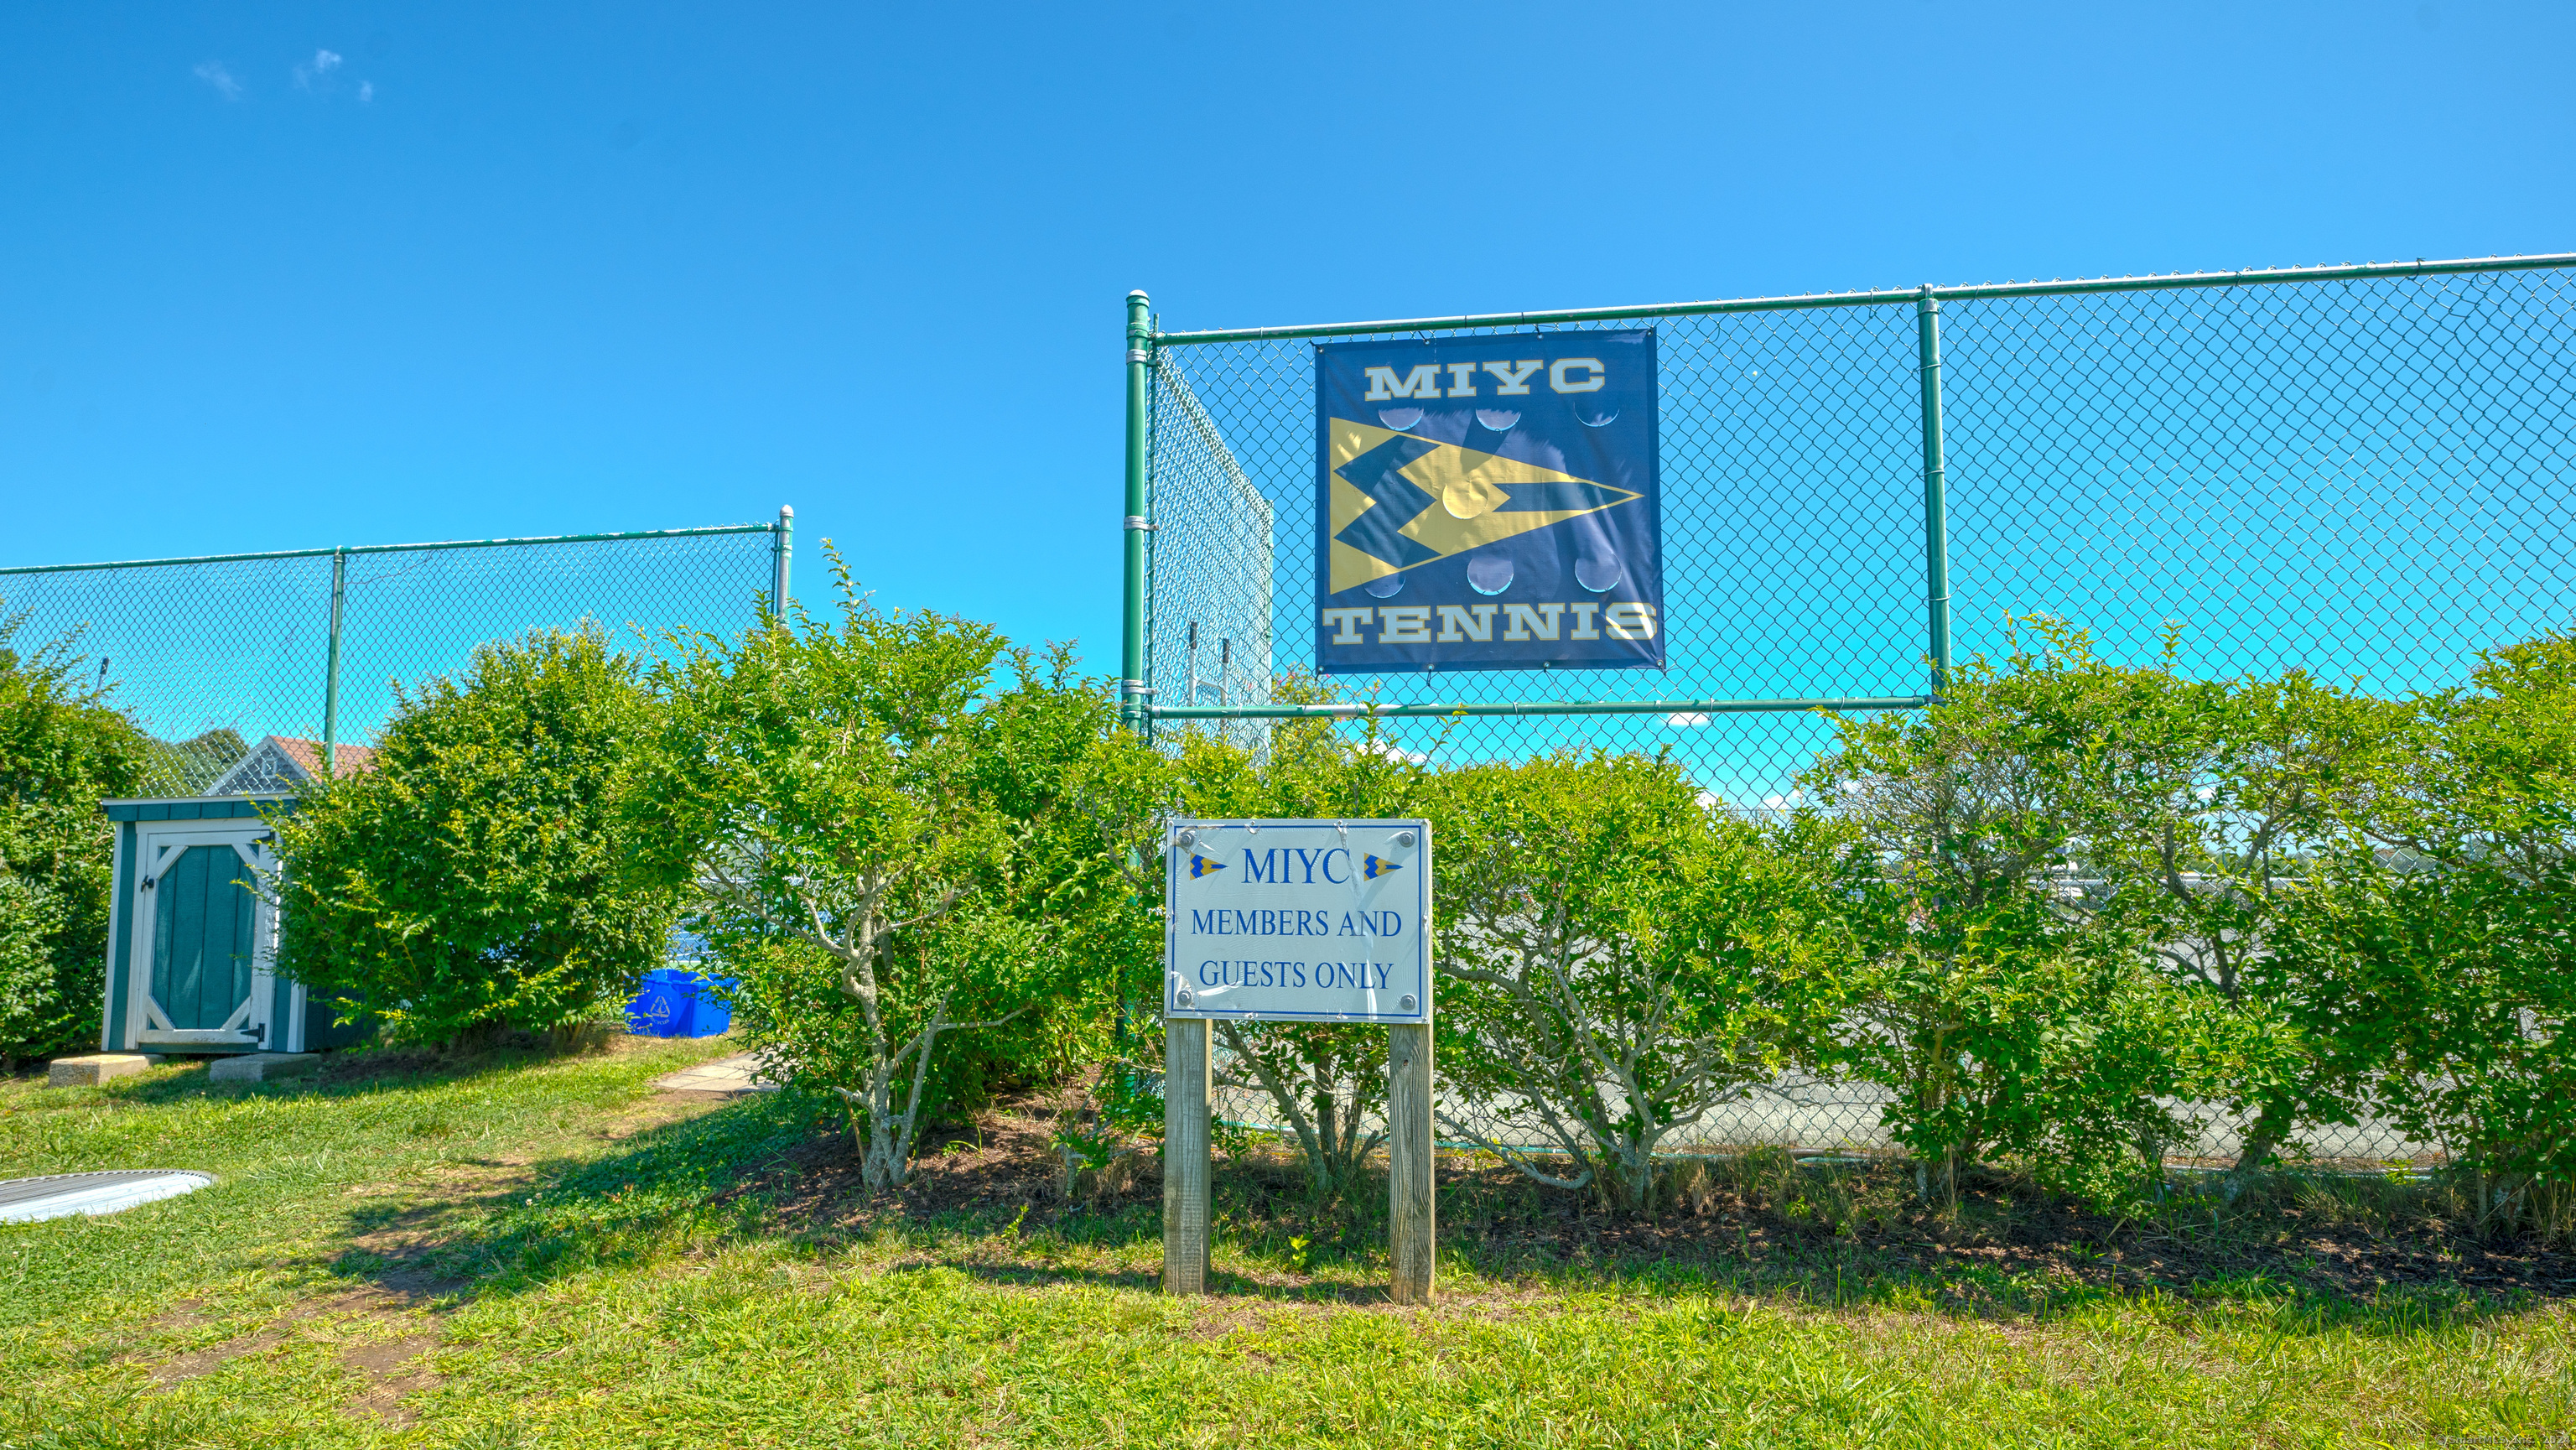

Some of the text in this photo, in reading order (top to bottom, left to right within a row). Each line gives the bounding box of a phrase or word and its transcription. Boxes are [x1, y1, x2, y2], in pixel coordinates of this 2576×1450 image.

[1364, 357, 1606, 402] MIYC
[1322, 602, 1658, 645] TENNIS
[1241, 848, 1351, 884] MIYC
[1191, 909, 1402, 938] MEMBERS AND
[1199, 960, 1394, 990] GUESTS ONLY
